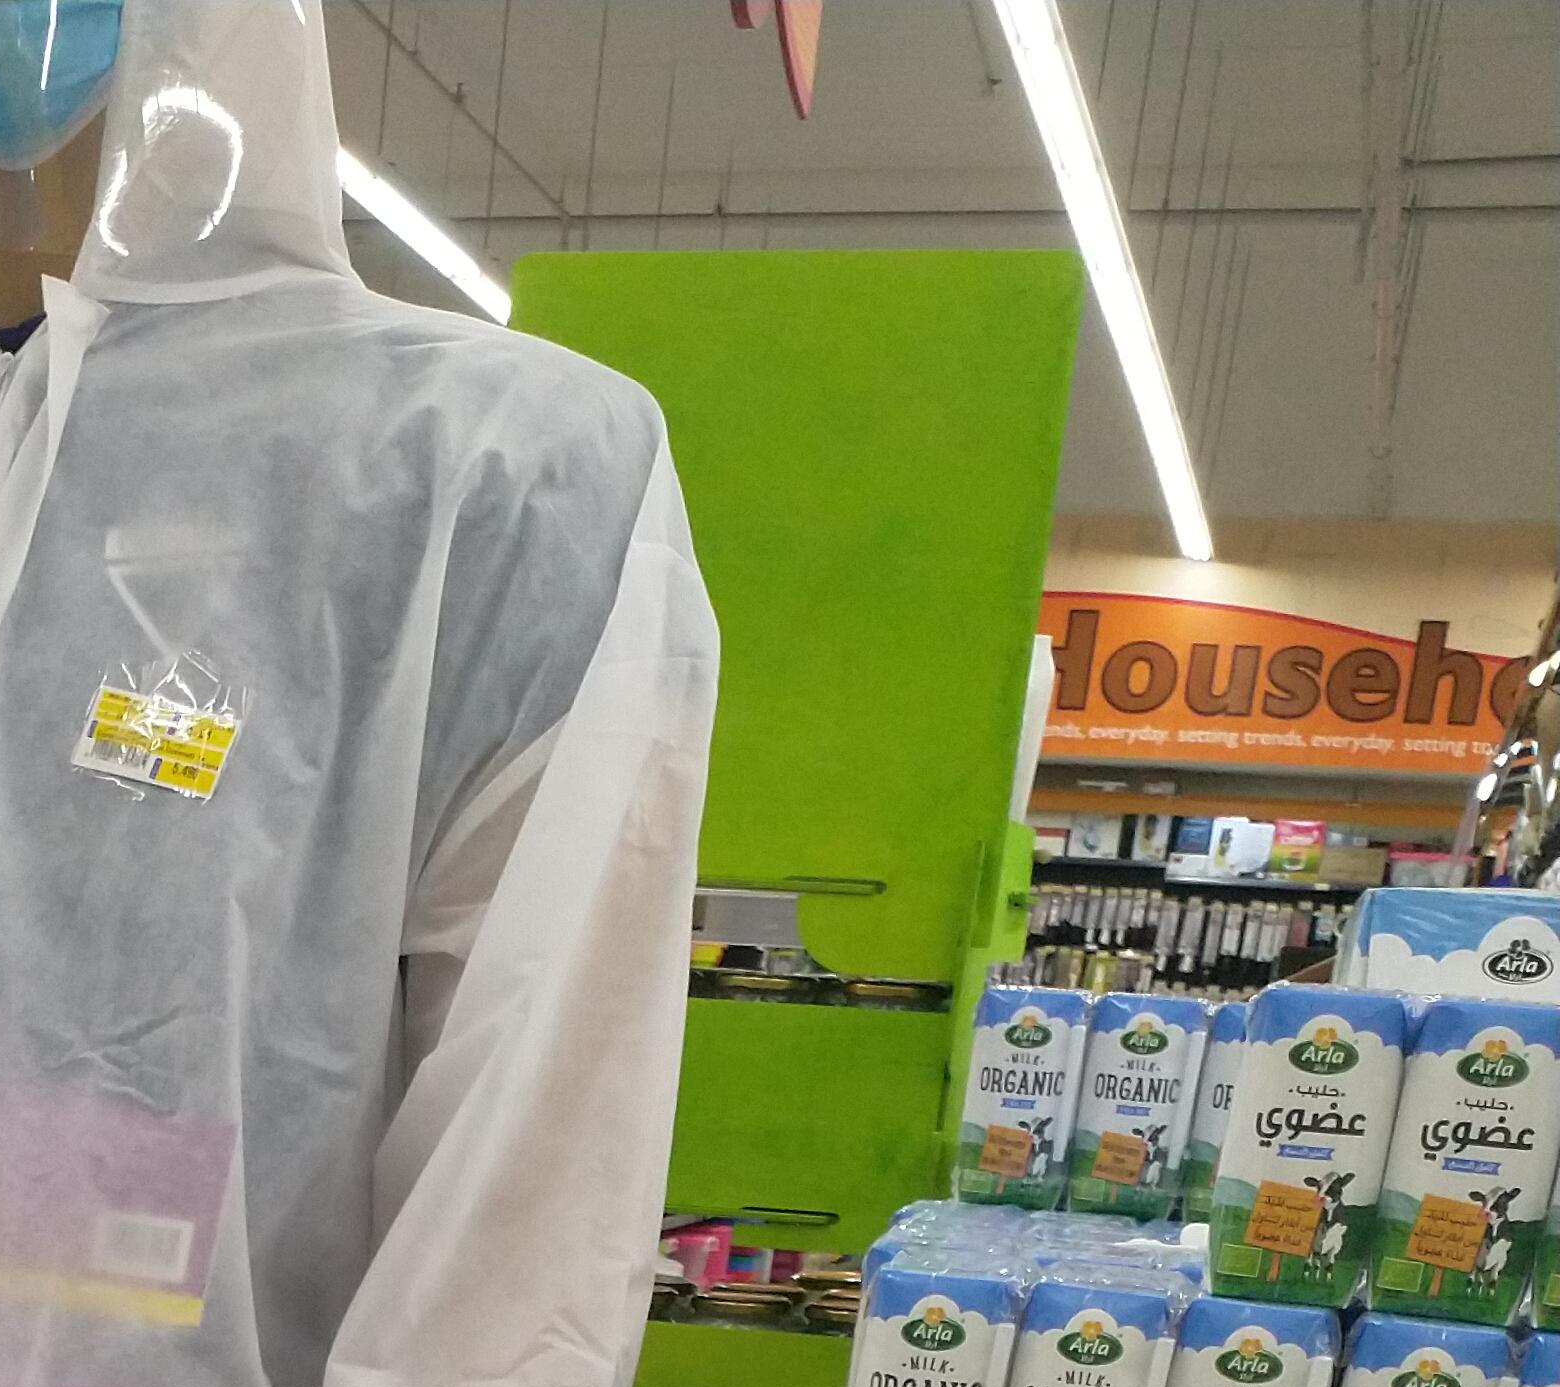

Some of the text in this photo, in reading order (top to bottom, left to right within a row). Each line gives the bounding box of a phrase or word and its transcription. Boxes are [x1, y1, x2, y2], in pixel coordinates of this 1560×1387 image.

[1493, 951, 1542, 978] Arla
[1301, 1042, 1347, 1067] Arla
[1470, 1054, 1517, 1079] Arla
[980, 1066, 1065, 1098] ORGANIC
[1093, 1073, 1180, 1105] ORGANIC
[1296, 1082, 1342, 1101] حليب
[1462, 1096, 1509, 1114] حليب
[1254, 1101, 1368, 1150] عضوي
[1419, 1112, 1537, 1164] عضوي
[912, 1323, 955, 1345] Arla
[910, 1355, 952, 1375] MILK
[1227, 1356, 1270, 1376] Arla
